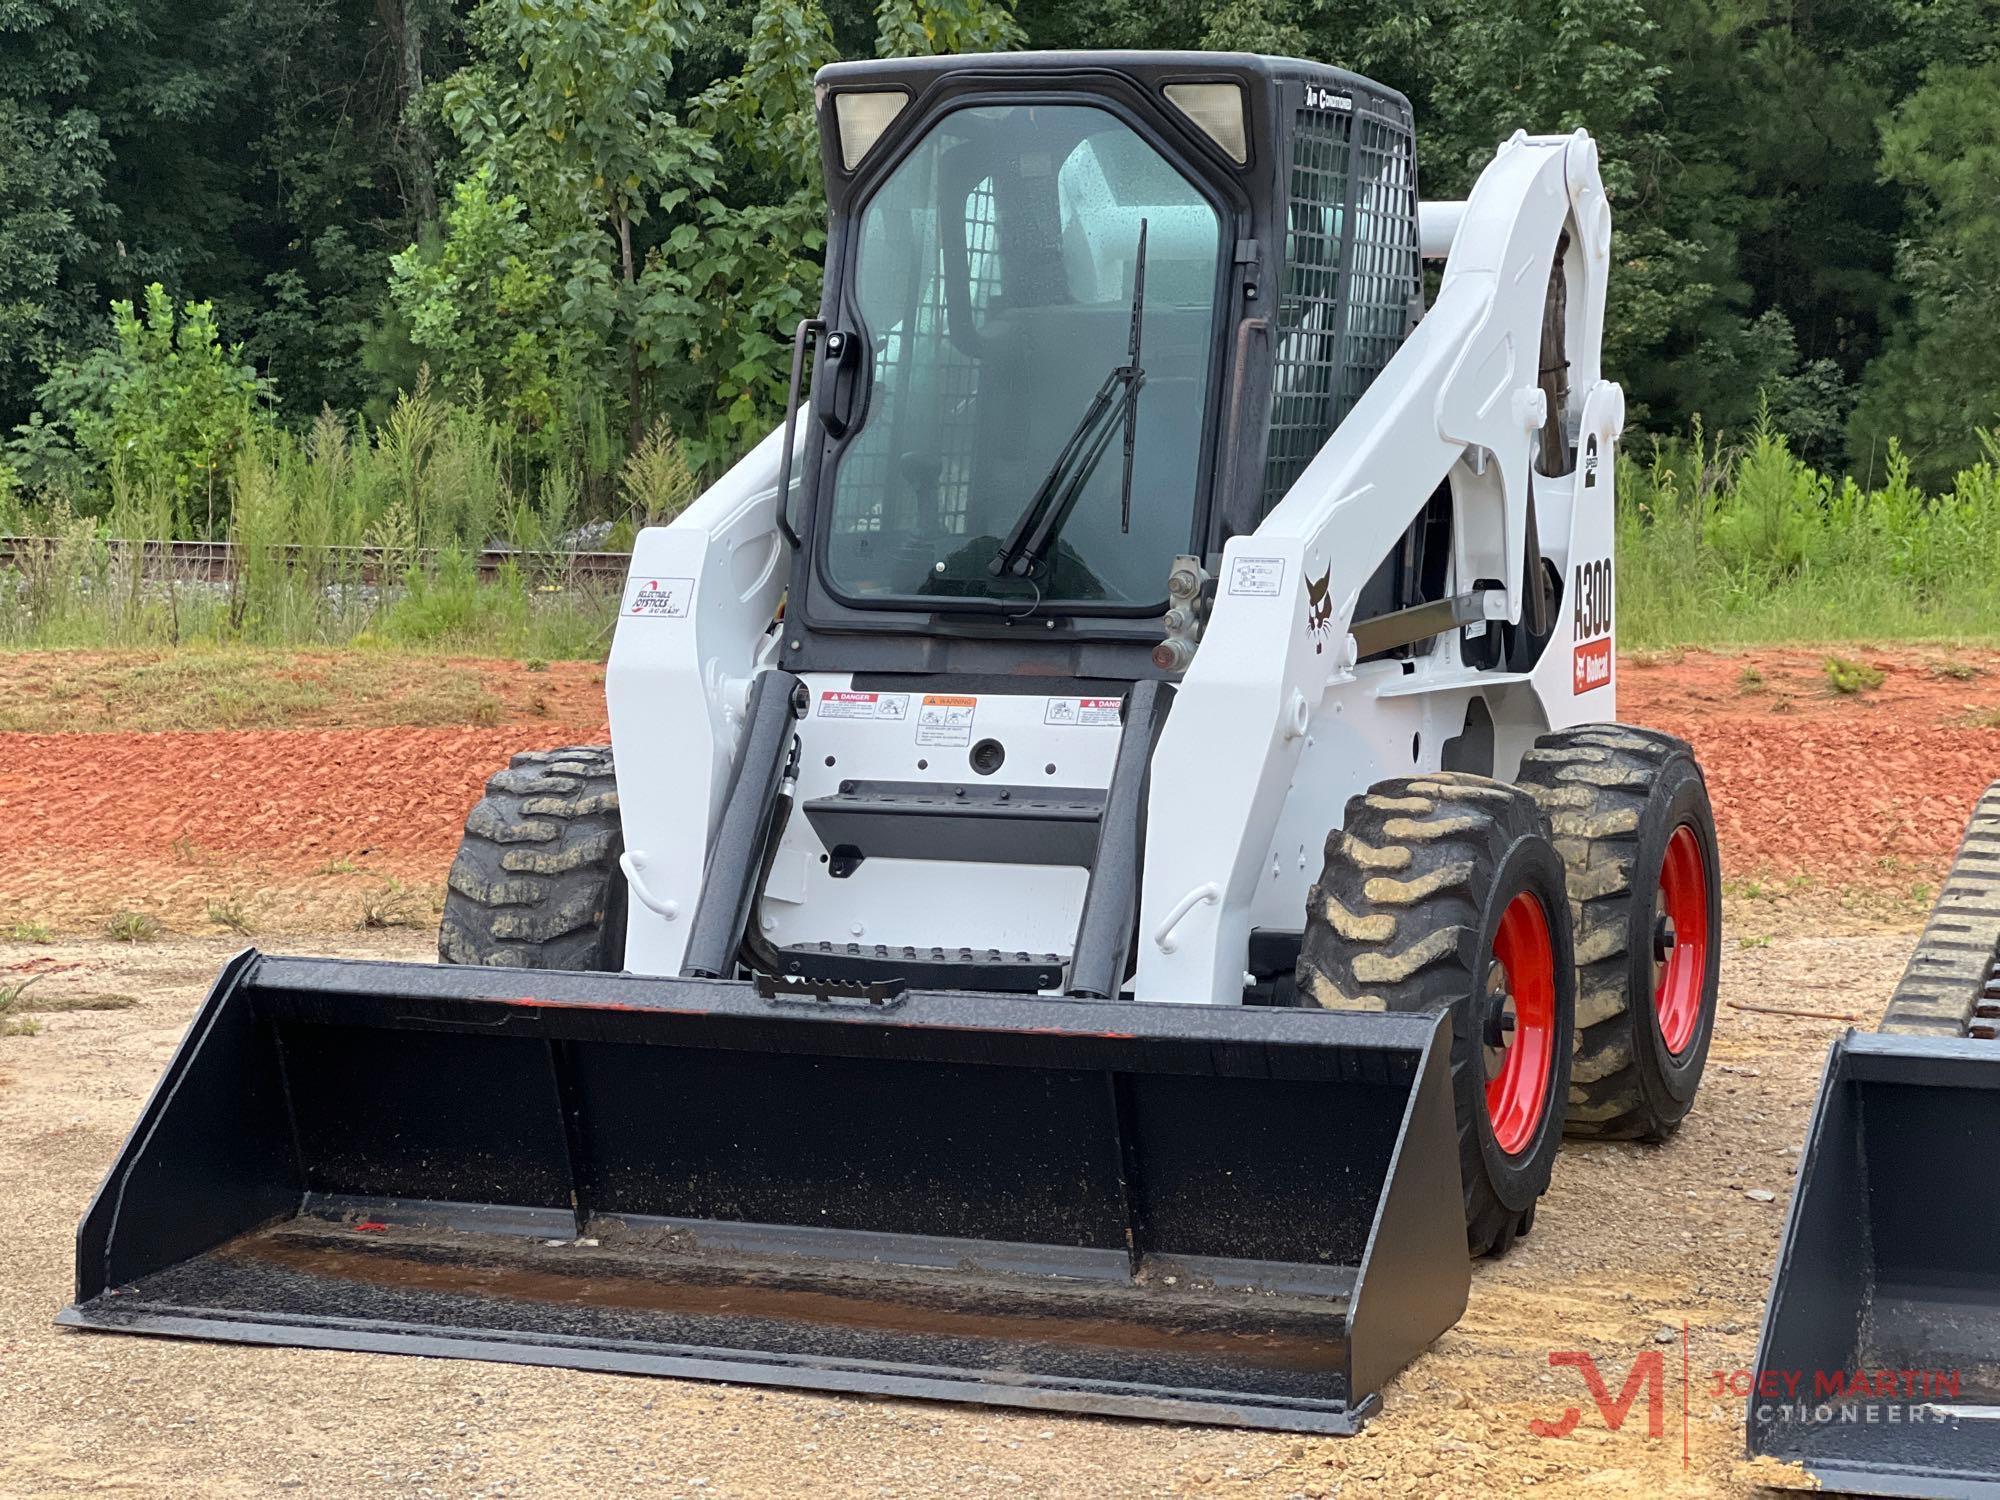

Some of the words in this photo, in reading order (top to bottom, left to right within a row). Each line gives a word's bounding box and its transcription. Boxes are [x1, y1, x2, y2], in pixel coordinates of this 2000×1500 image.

[1574, 558, 1611, 641] A300
[940, 698, 972, 706] WARNING
[1098, 700, 1121, 708] DANG
